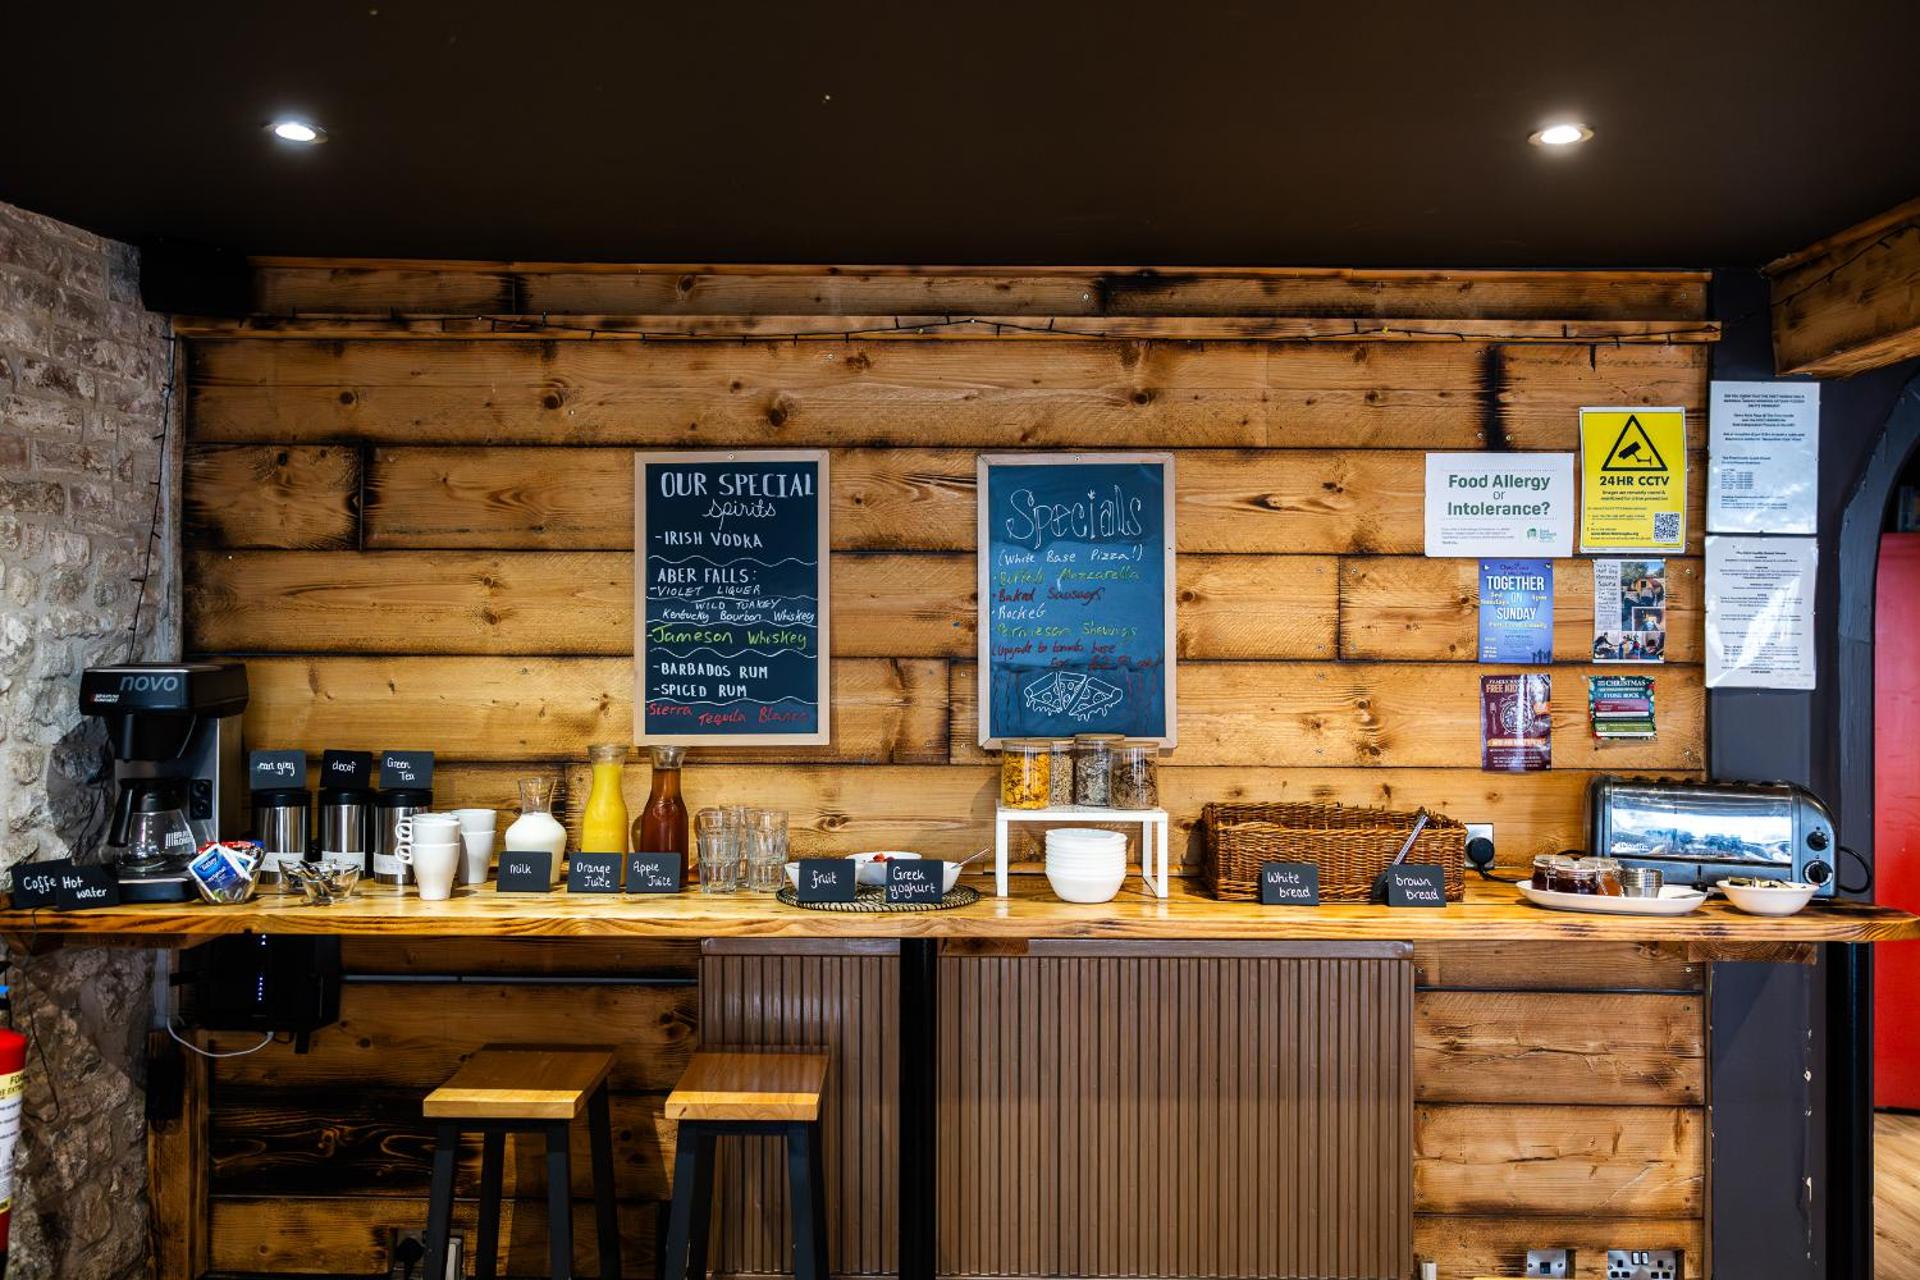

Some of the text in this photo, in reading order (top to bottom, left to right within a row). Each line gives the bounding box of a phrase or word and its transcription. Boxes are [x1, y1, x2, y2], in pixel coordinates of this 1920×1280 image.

[661, 472, 815, 498] OUR SPECIAL
[1448, 474, 1551, 491] Food Allergy
[1599, 476, 1670, 486] 24HR CCTV
[1447, 501, 1551, 516] Intolerance?
[1005, 484, 1142, 550] Specials
[710, 532, 763, 548] VODKA
[1047, 550, 1076, 562] Base
[657, 568, 697, 583] ABER
[1486, 575, 1545, 591] TOGETHER
[695, 601, 726, 610] WILD
[720, 610, 762, 621] Bourbon
[1496, 607, 1537, 620] SUNDAY
[747, 631, 807, 649] Whiskey
[739, 665, 768, 679] RUM
[120, 675, 178, 692] novo
[718, 684, 747, 697] RUM
[387, 757, 411, 769] Green
[399, 771, 416, 781] Tea
[576, 862, 611, 875] Orange
[633, 861, 660, 875] Apple
[892, 866, 925, 881] Greek
[62, 876, 84, 889] Hot
[584, 876, 611, 888] Juice
[647, 875, 672, 887] Juice
[1395, 874, 1432, 887] brown
[889, 882, 936, 899] yoghurt
[1279, 886, 1311, 898] bread
[1405, 889, 1440, 900] bread
